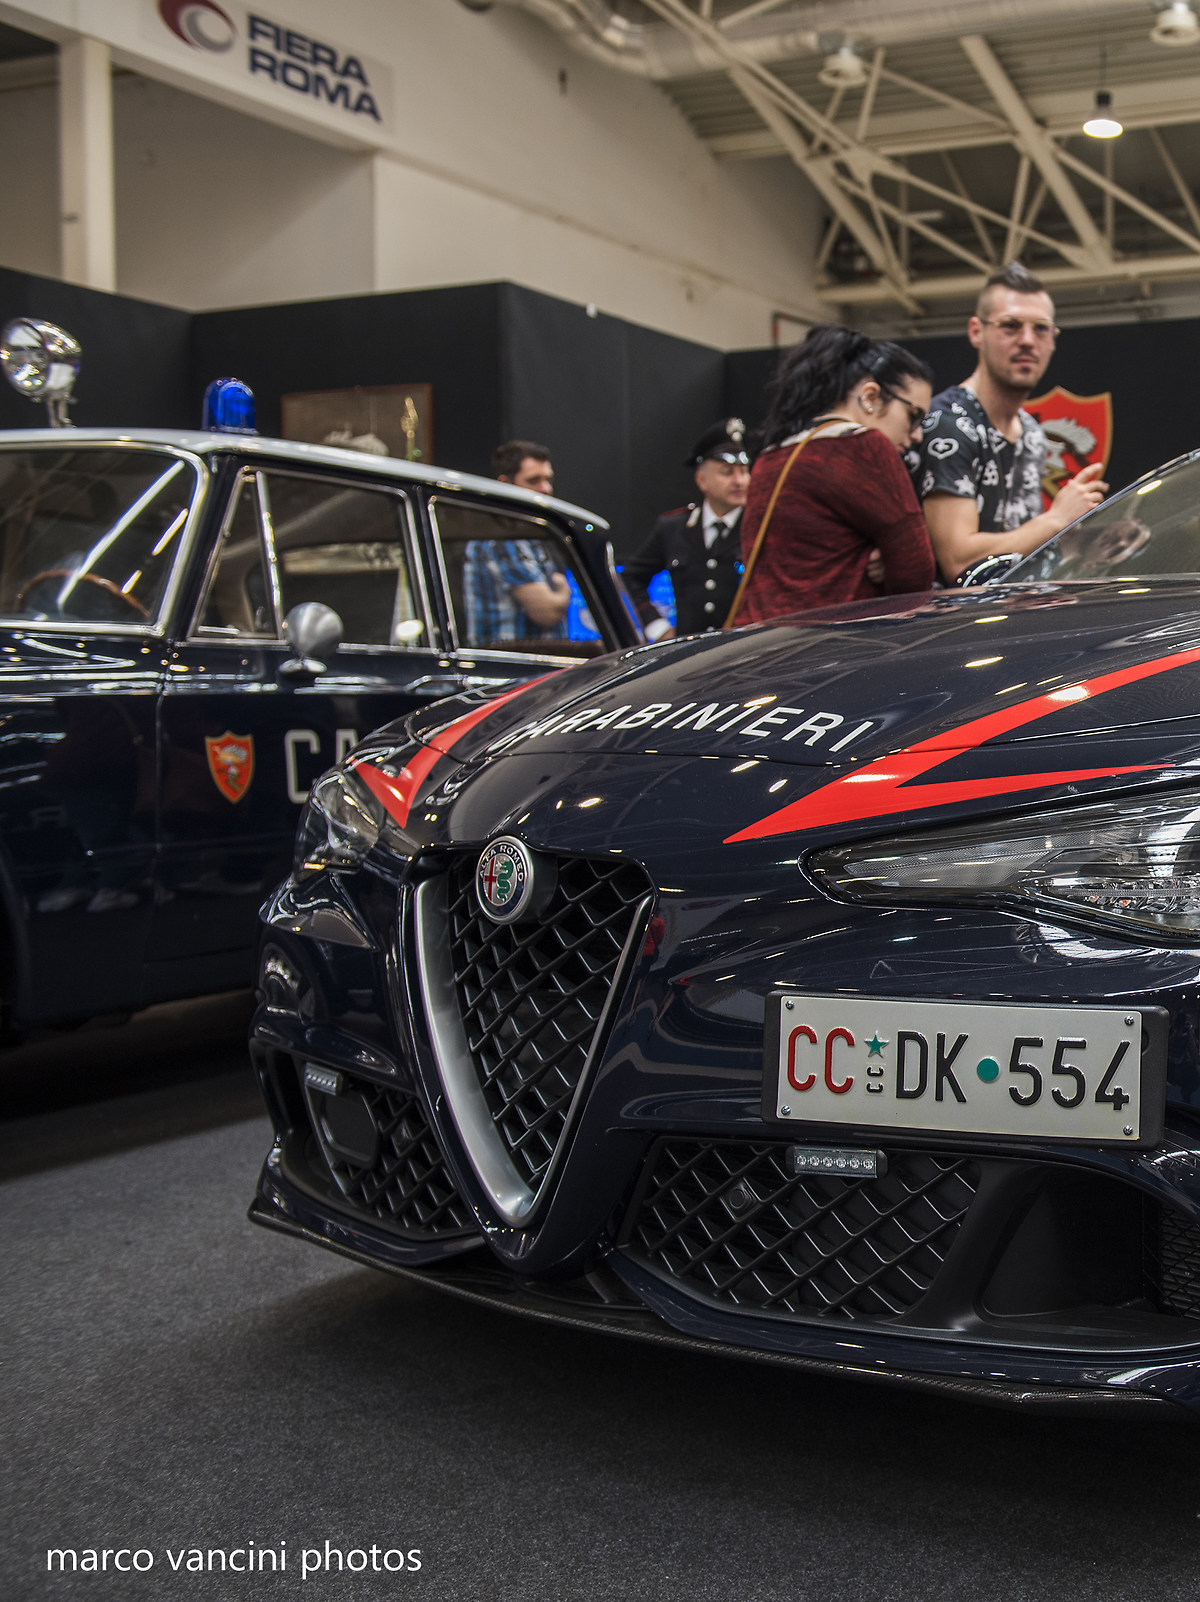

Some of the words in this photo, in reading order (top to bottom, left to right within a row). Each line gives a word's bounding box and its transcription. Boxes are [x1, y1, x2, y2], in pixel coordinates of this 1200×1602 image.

[248, 13, 369, 88] FIERA
[249, 47, 381, 122] ROMA
[486, 702, 874, 753] CARABINIERI
[480, 849, 497, 878] ALFA
[500, 844, 524, 882] ROMEO
[787, 1025, 855, 1094] CC
[896, 1030, 969, 1103] DK
[1009, 1036, 1131, 1111] 554
